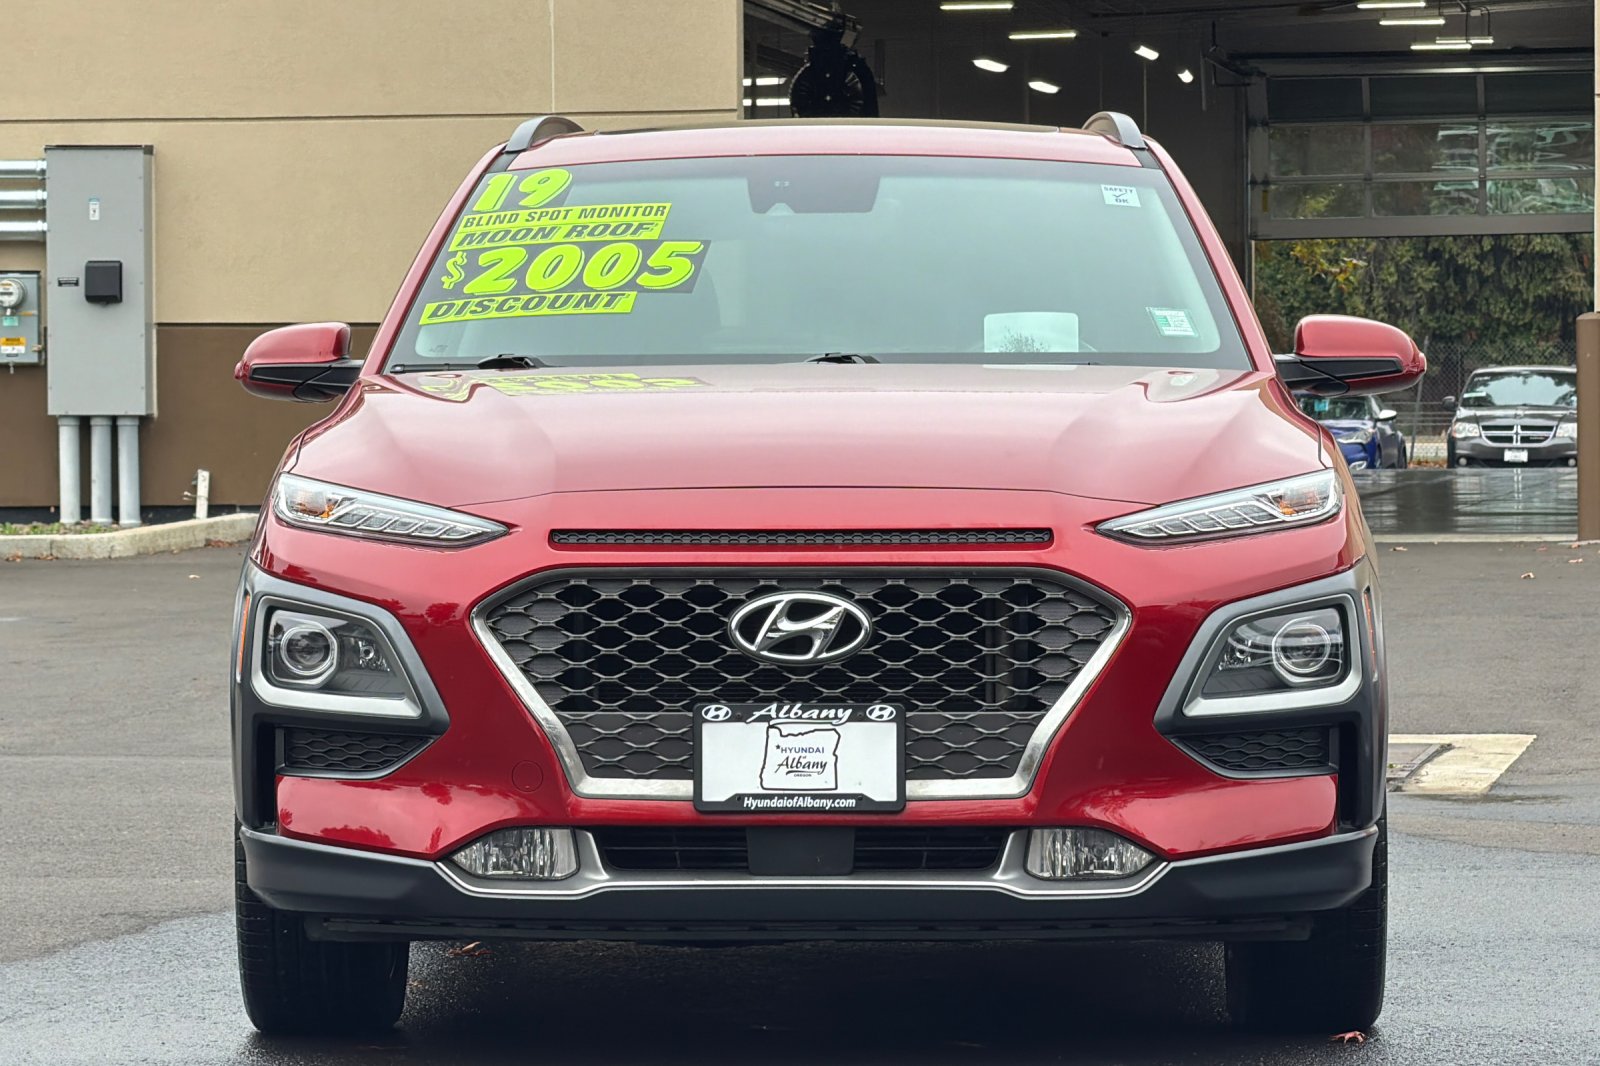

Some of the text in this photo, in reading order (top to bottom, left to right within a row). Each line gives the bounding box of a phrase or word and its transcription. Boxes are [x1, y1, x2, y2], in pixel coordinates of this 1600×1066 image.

[473, 169, 573, 211] 19
[463, 204, 667, 229] BLIND SPOT MONITOR
[456, 221, 657, 247] MOON ROOF
[441, 241, 704, 294] $2005
[427, 293, 629, 319] DISCOUNT
[746, 703, 852, 726] Albany
[780, 746, 825, 754] HYUNDAI
[775, 755, 828, 776] Albany
[743, 796, 856, 810] HyundaiofAlbany.com
